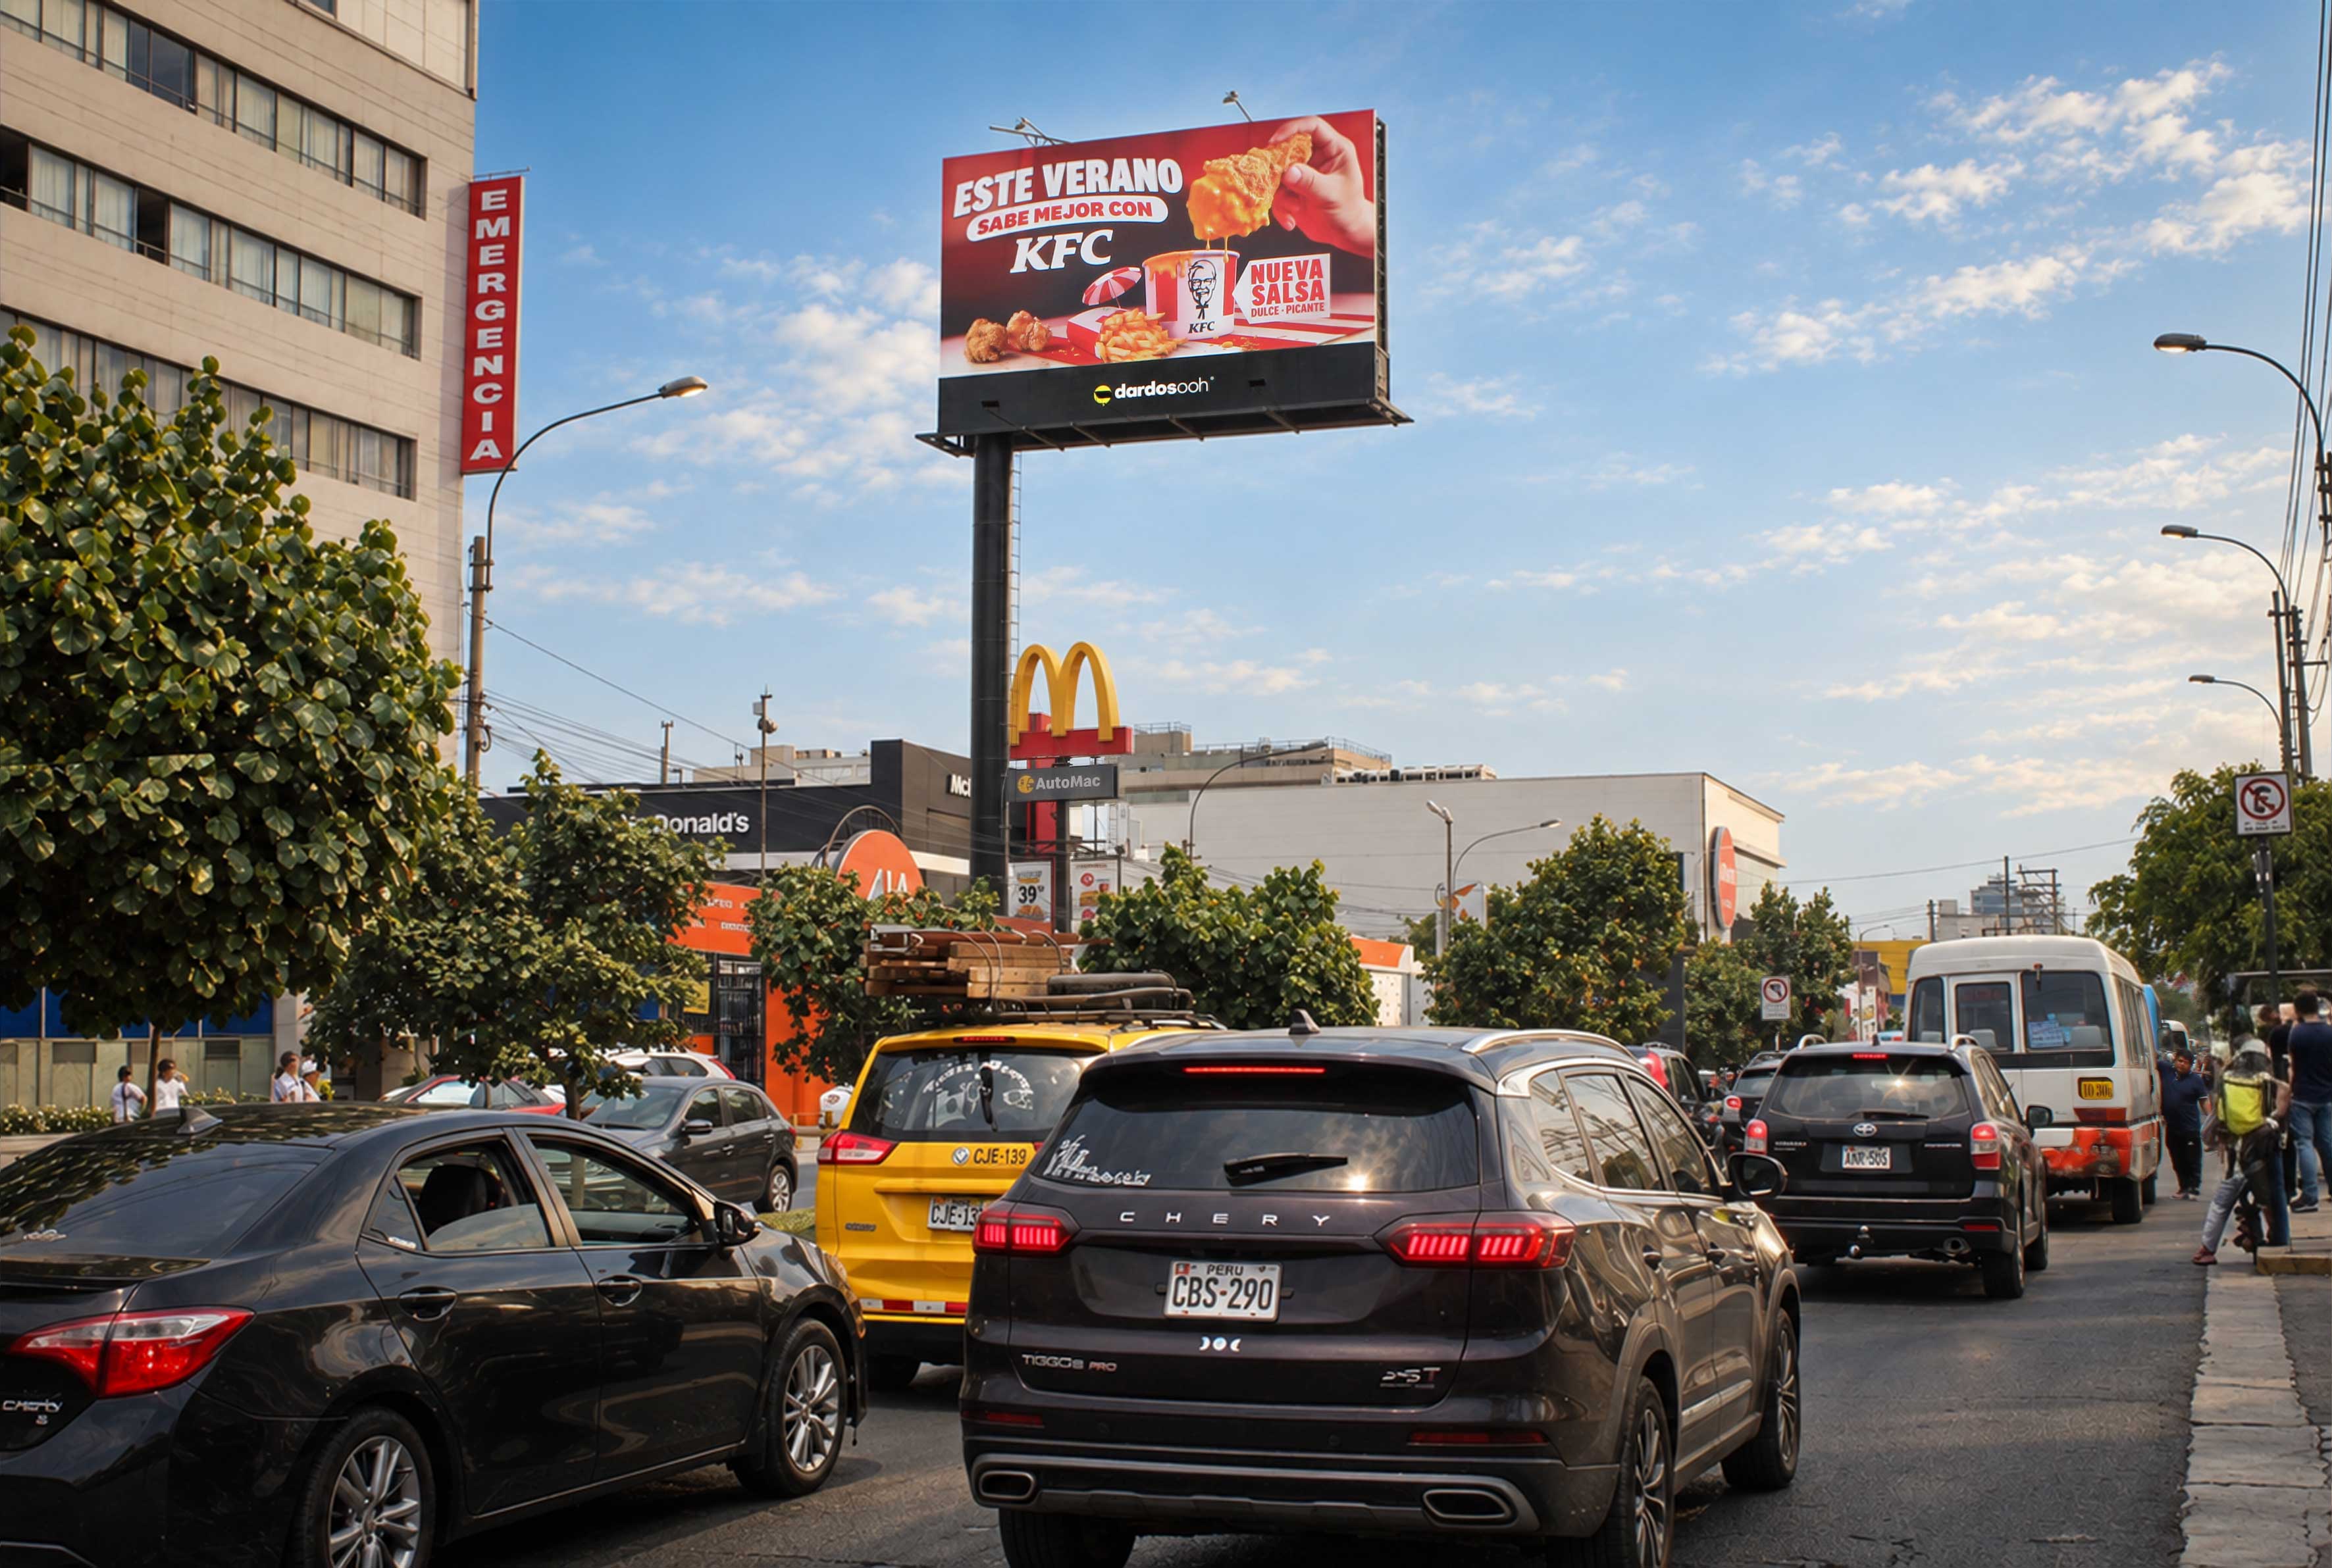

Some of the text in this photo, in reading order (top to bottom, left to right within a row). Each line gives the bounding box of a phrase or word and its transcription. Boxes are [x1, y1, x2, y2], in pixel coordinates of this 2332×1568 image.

[953, 158, 1183, 218] ESTE VERANO
[977, 201, 1153, 236] SABE MEJOR CON
[1010, 229, 1114, 273] KFC
[1251, 258, 1324, 285] NUEVA
[1251, 280, 1325, 306] SALSA
[1251, 302, 1325, 317] DULCE PICANTE
[469, 189, 510, 460] EMERGENCIA
[1187, 320, 1216, 334] KFC
[1114, 377, 1209, 399] dardosooh
[1035, 775, 1101, 790] AutoMac
[621, 812, 750, 834] Donald's
[973, 1148, 1027, 1165] CJE-139
[931, 1204, 983, 1226] CJE-13
[1120, 1211, 1330, 1227] CHERY
[1206, 1263, 1244, 1276] PERU
[1172, 1275, 1274, 1311] CBS-290
